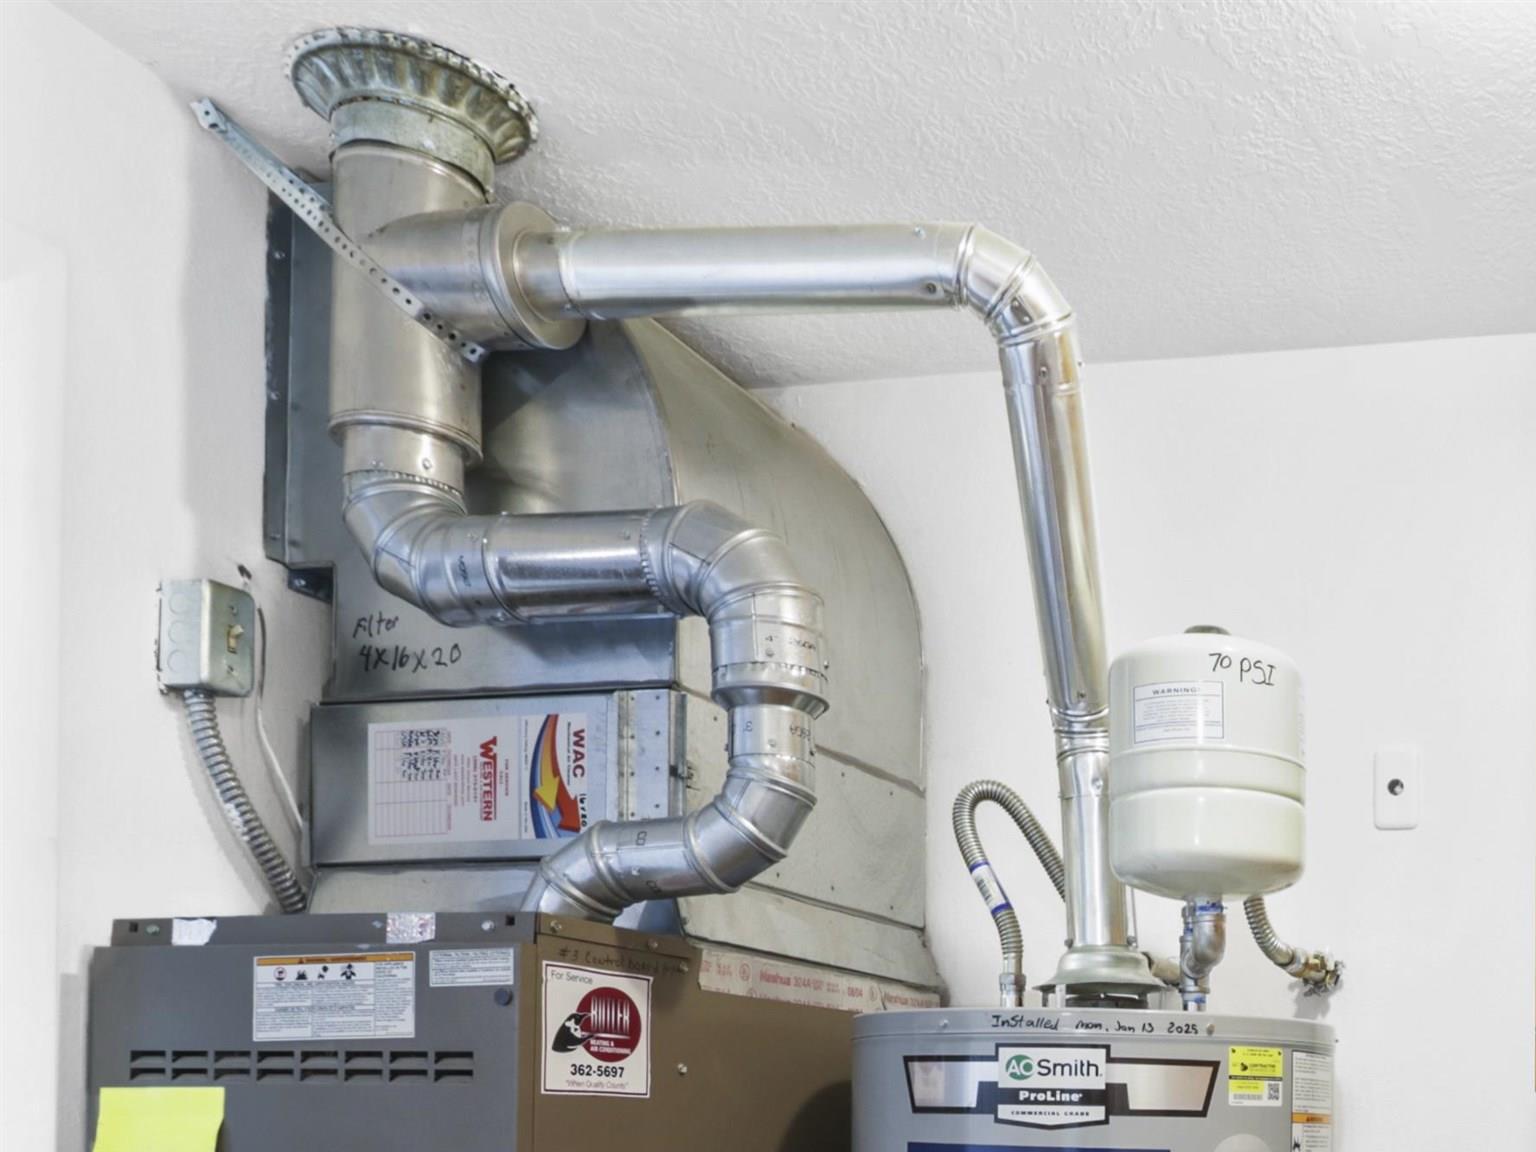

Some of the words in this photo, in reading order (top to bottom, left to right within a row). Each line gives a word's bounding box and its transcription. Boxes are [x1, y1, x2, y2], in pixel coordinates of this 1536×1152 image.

[353, 610, 399, 639] Filter
[1208, 652, 1232, 672] 70
[1239, 656, 1276, 686] PSI
[572, 728, 585, 778] WAC
[479, 735, 498, 822] WESTERN
[551, 969, 565, 980] For
[567, 972, 593, 986] Service
[990, 1014, 1059, 1031] Installed
[1166, 1022, 1199, 1035] 2025
[570, 1063, 625, 1078] 362-5697
[1037, 1057, 1099, 1078] Smith
[1018, 1090, 1079, 1103] ProLine
